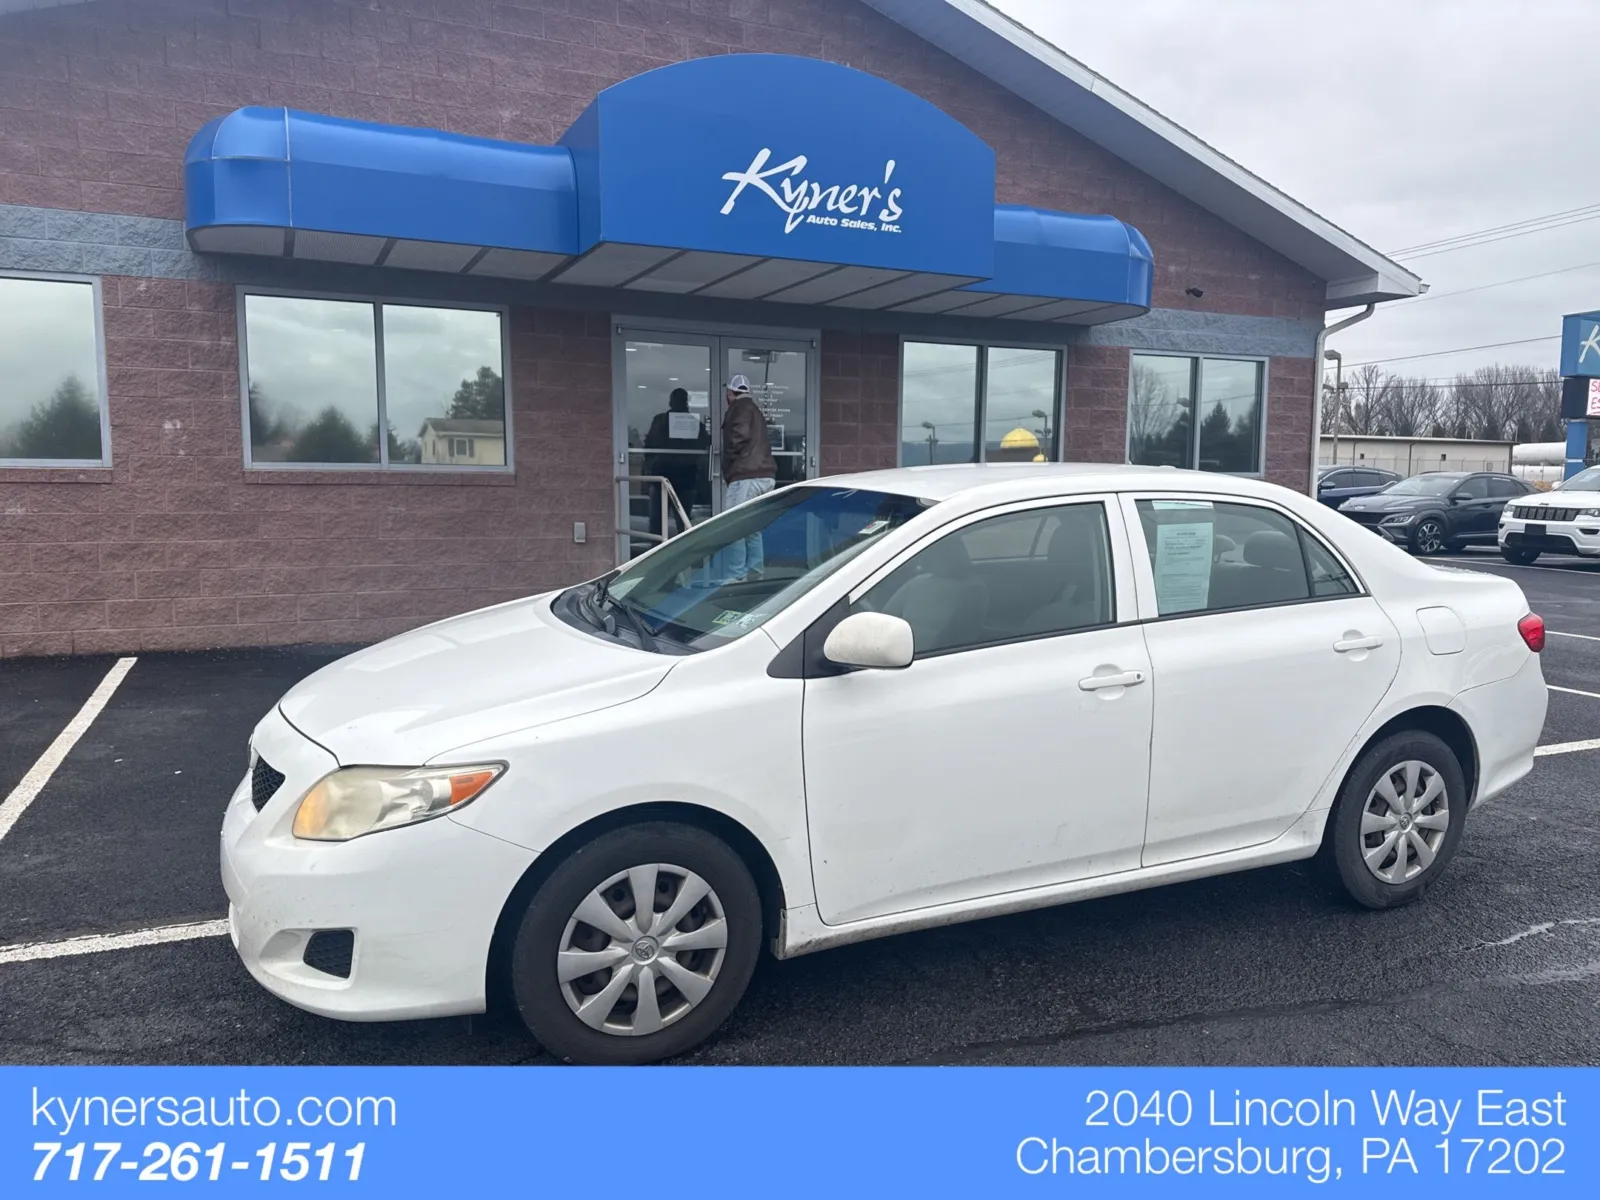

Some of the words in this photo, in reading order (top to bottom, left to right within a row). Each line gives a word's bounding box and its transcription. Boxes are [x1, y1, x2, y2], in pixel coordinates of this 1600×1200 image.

[720, 147, 903, 233] Kyner's
[806, 214, 838, 226] Auto
[841, 218, 877, 231] Sales,
[881, 222, 902, 233] Inc.
